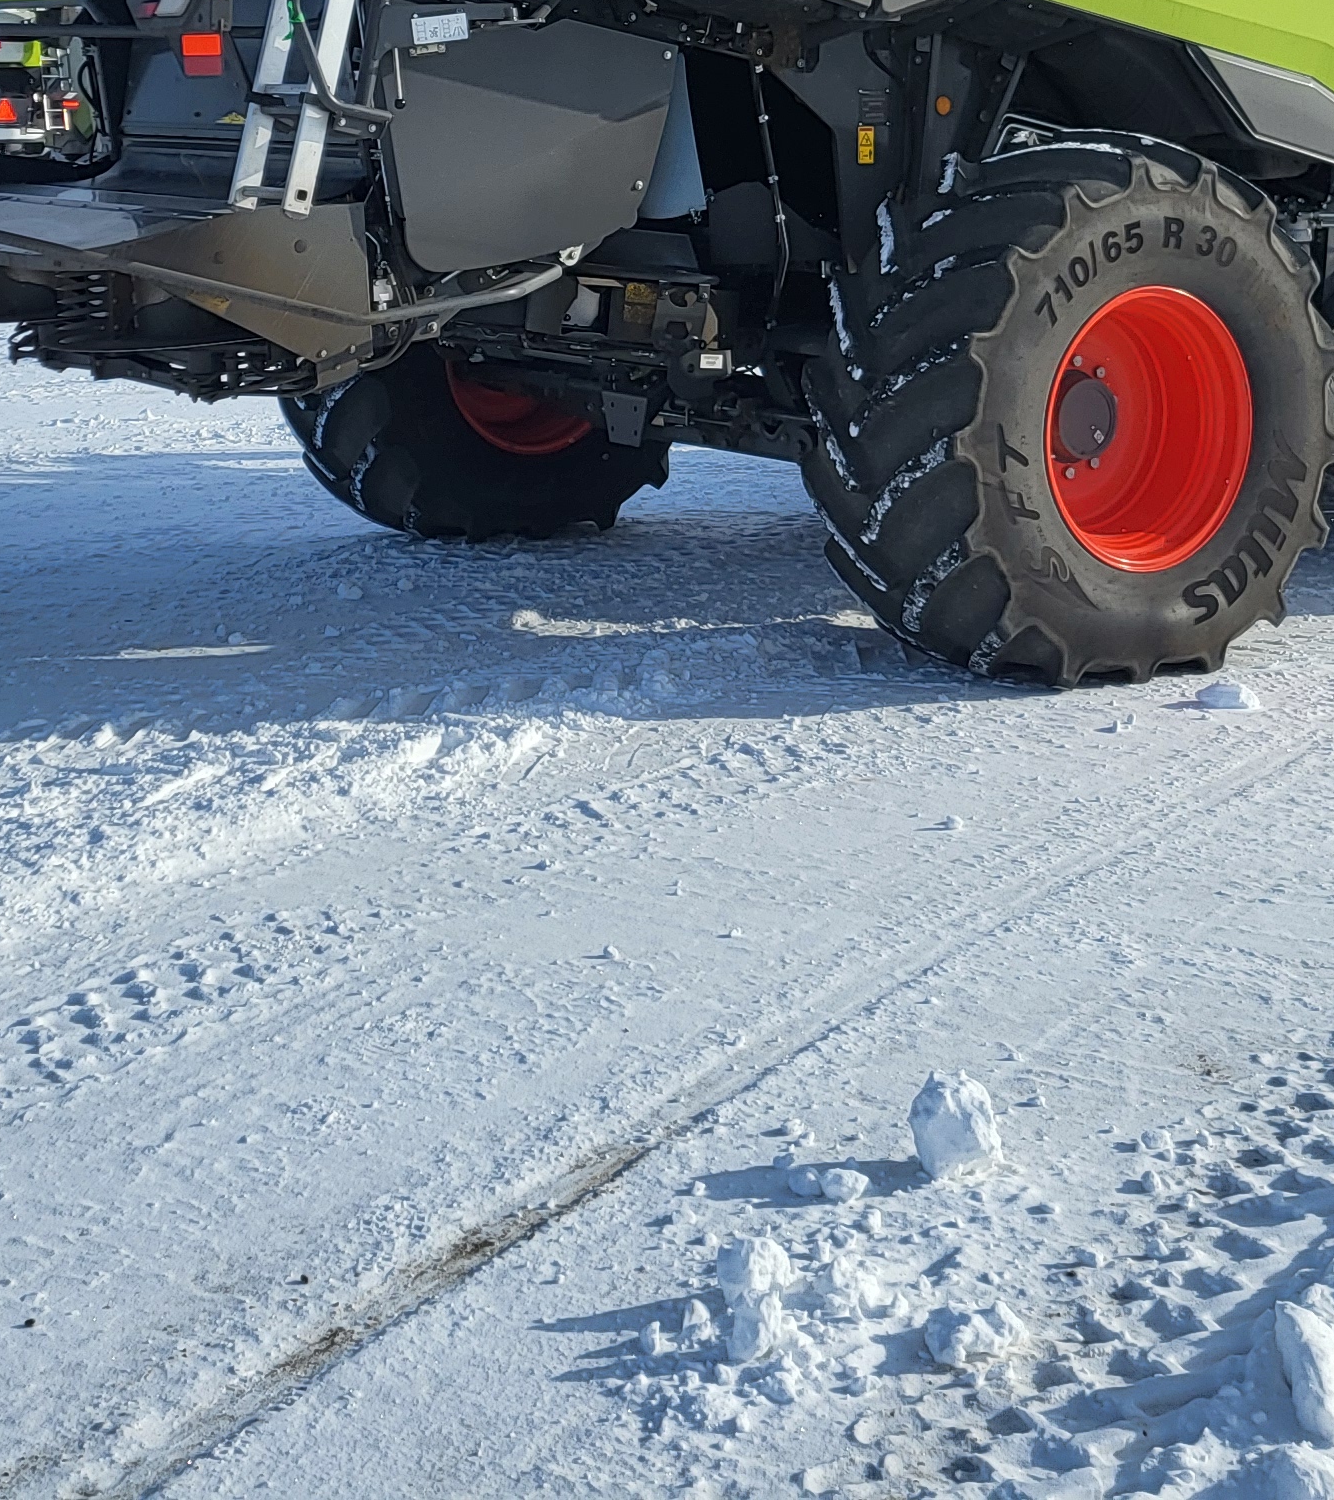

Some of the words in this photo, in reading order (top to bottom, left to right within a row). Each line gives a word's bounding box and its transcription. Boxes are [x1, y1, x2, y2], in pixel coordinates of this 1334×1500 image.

[1034, 219, 1144, 329] 710/65
[1162, 216, 1185, 250] R
[1195, 225, 1238, 268] 30
